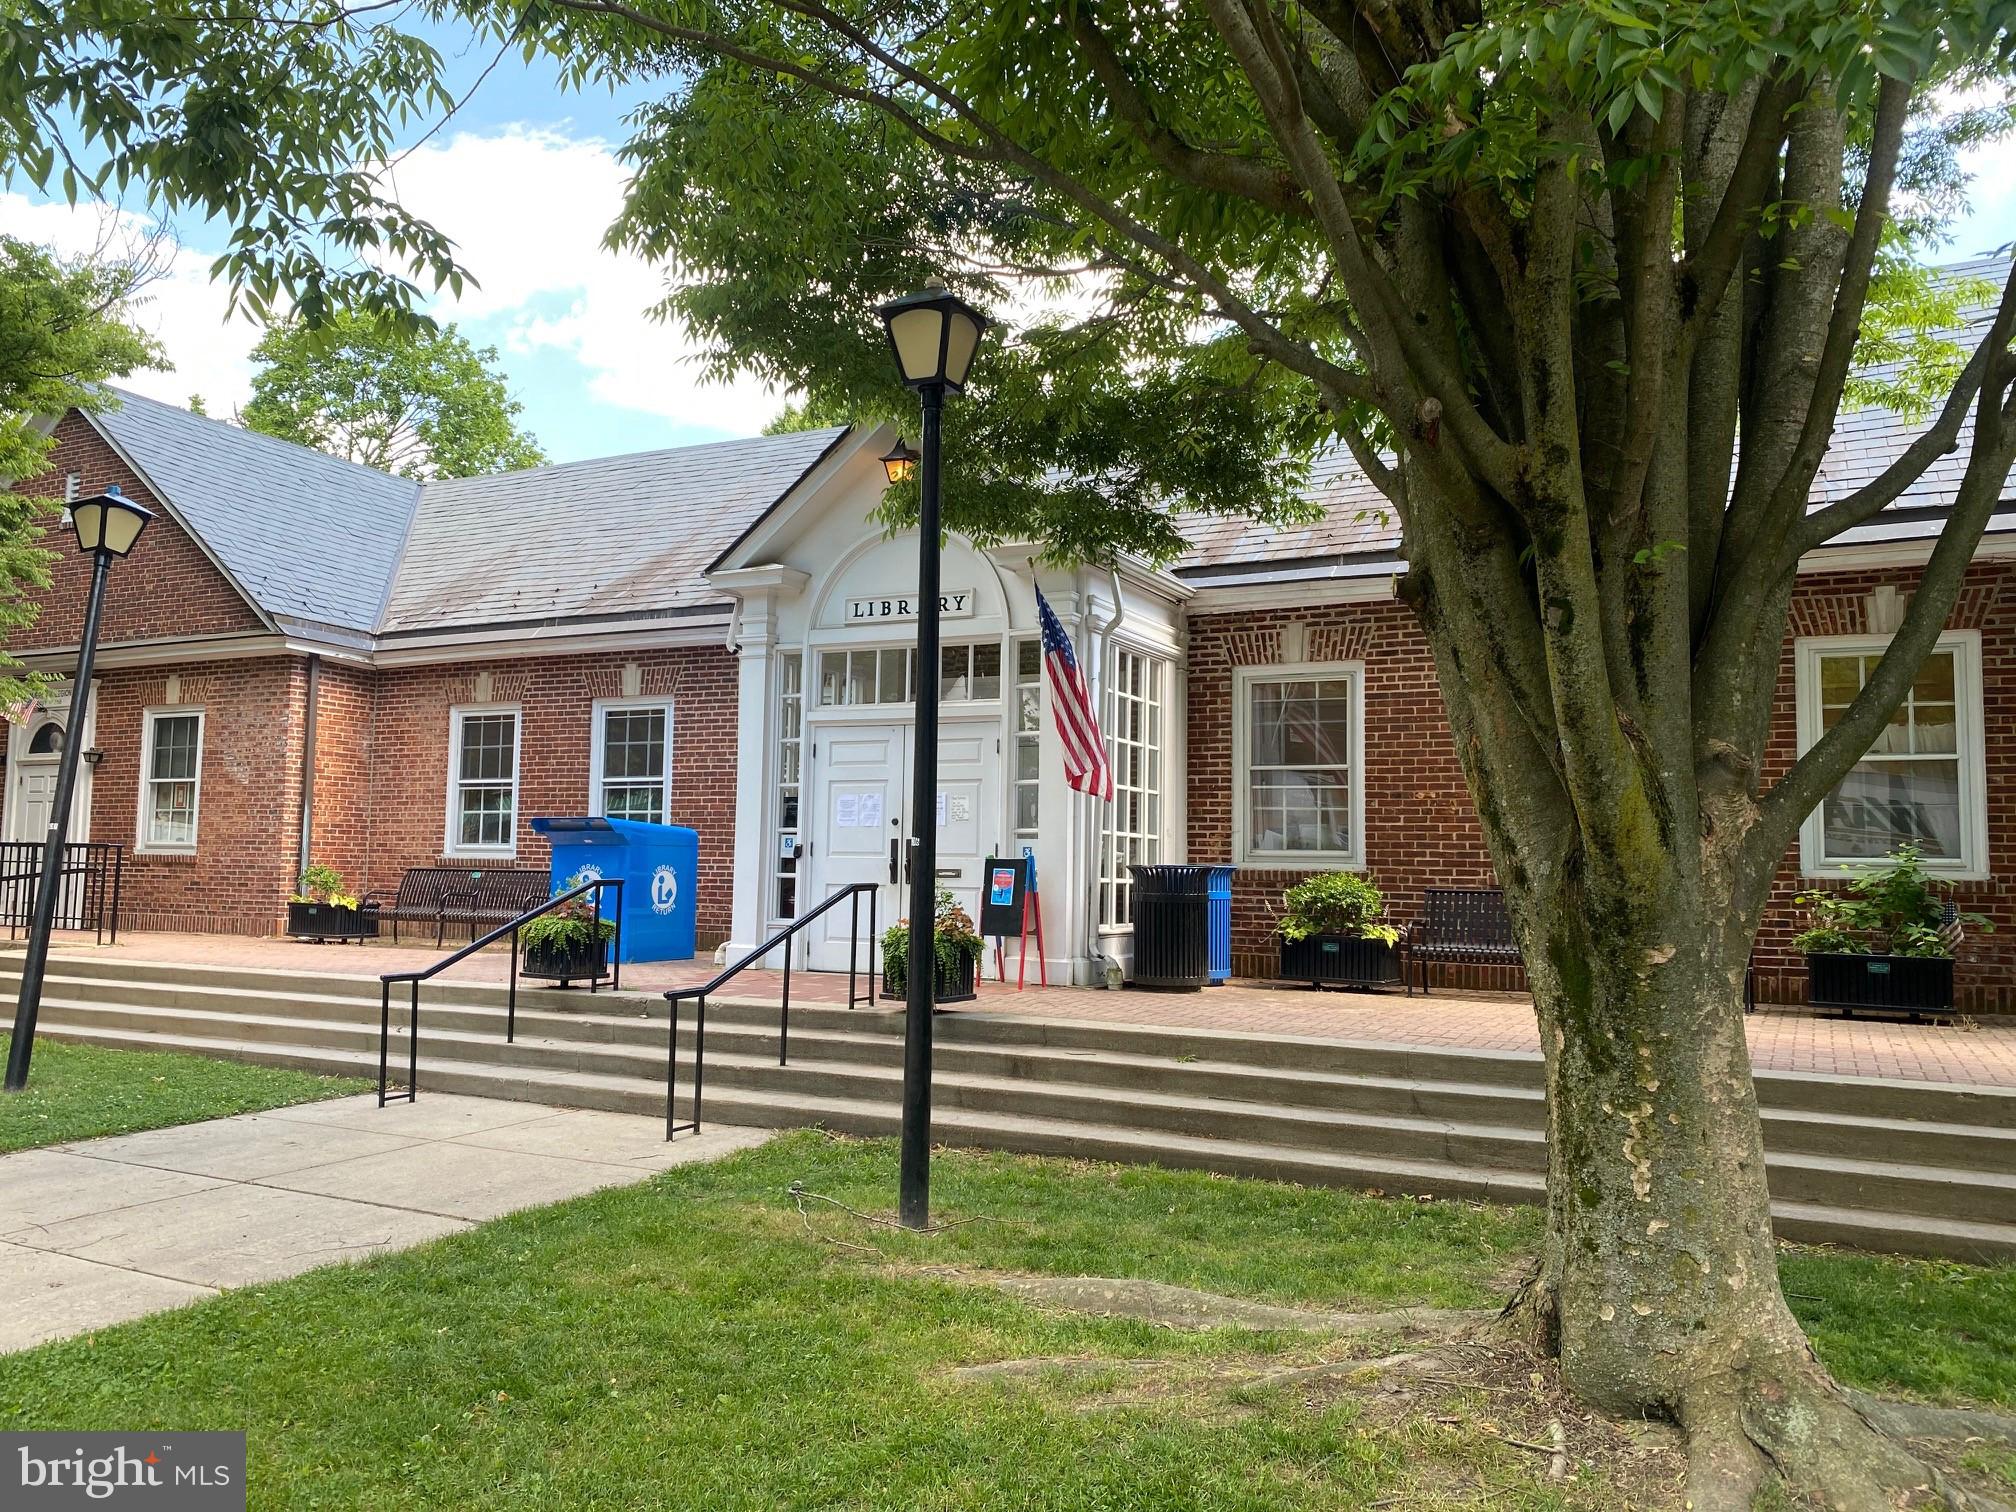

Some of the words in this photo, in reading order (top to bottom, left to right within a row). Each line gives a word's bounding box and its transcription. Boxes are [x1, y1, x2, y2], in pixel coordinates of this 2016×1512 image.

[852, 595, 966, 618] LIBRRY
[652, 864, 677, 877] LIBRARY
[651, 902, 676, 916] RETURN
